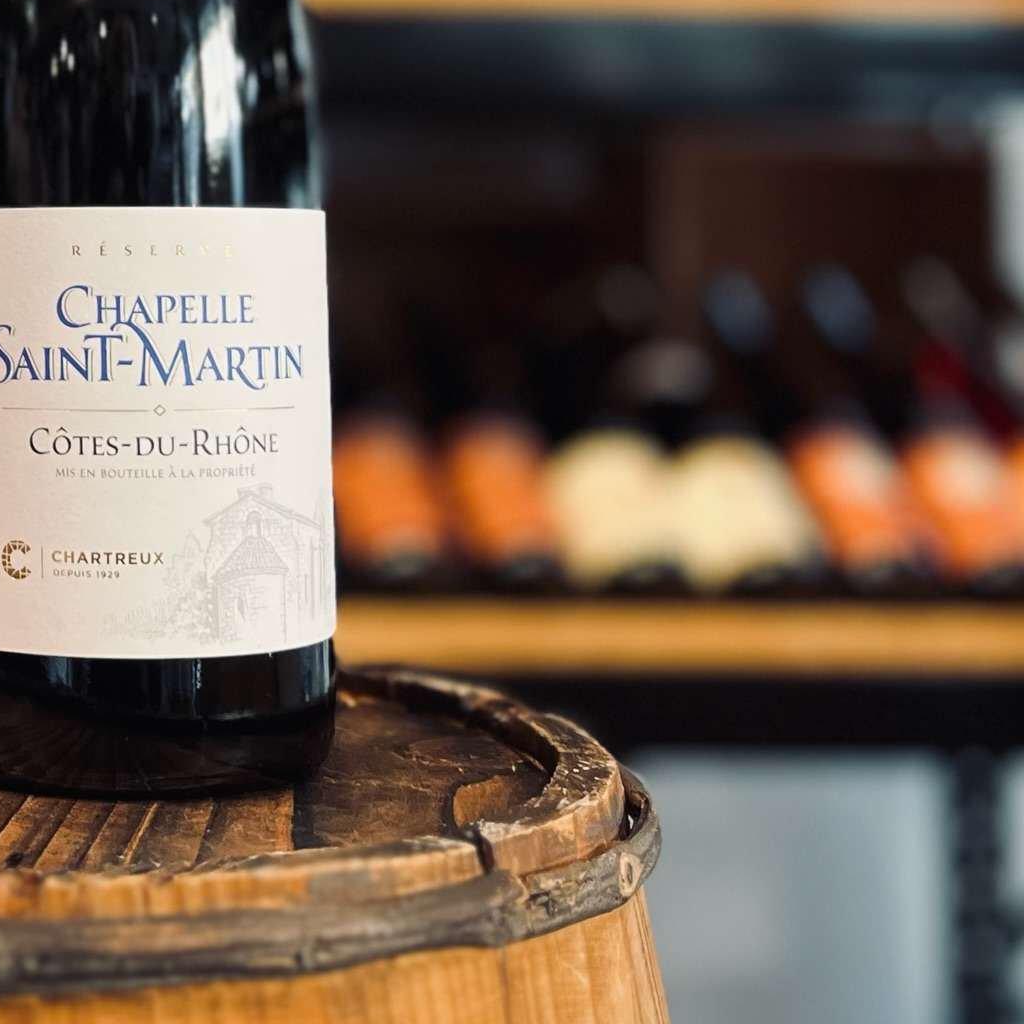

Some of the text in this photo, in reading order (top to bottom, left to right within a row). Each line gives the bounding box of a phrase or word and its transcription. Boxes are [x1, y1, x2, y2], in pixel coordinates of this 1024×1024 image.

[71, 240, 236, 257] RÉSERVE
[56, 284, 255, 329] CHAPELLE
[28, 426, 279, 457] CÔTES-DU-RHÔNE
[55, 467, 75, 478] MIS
[80, 468, 95, 478] EN
[101, 468, 164, 479] BOUTEILLE
[180, 468, 195, 478] LA
[199, 463, 257, 478] PROPRIÉTÉ
[51, 550, 164, 565] CHARTREUX
[52, 569, 120, 579] DEPUIS 1929
